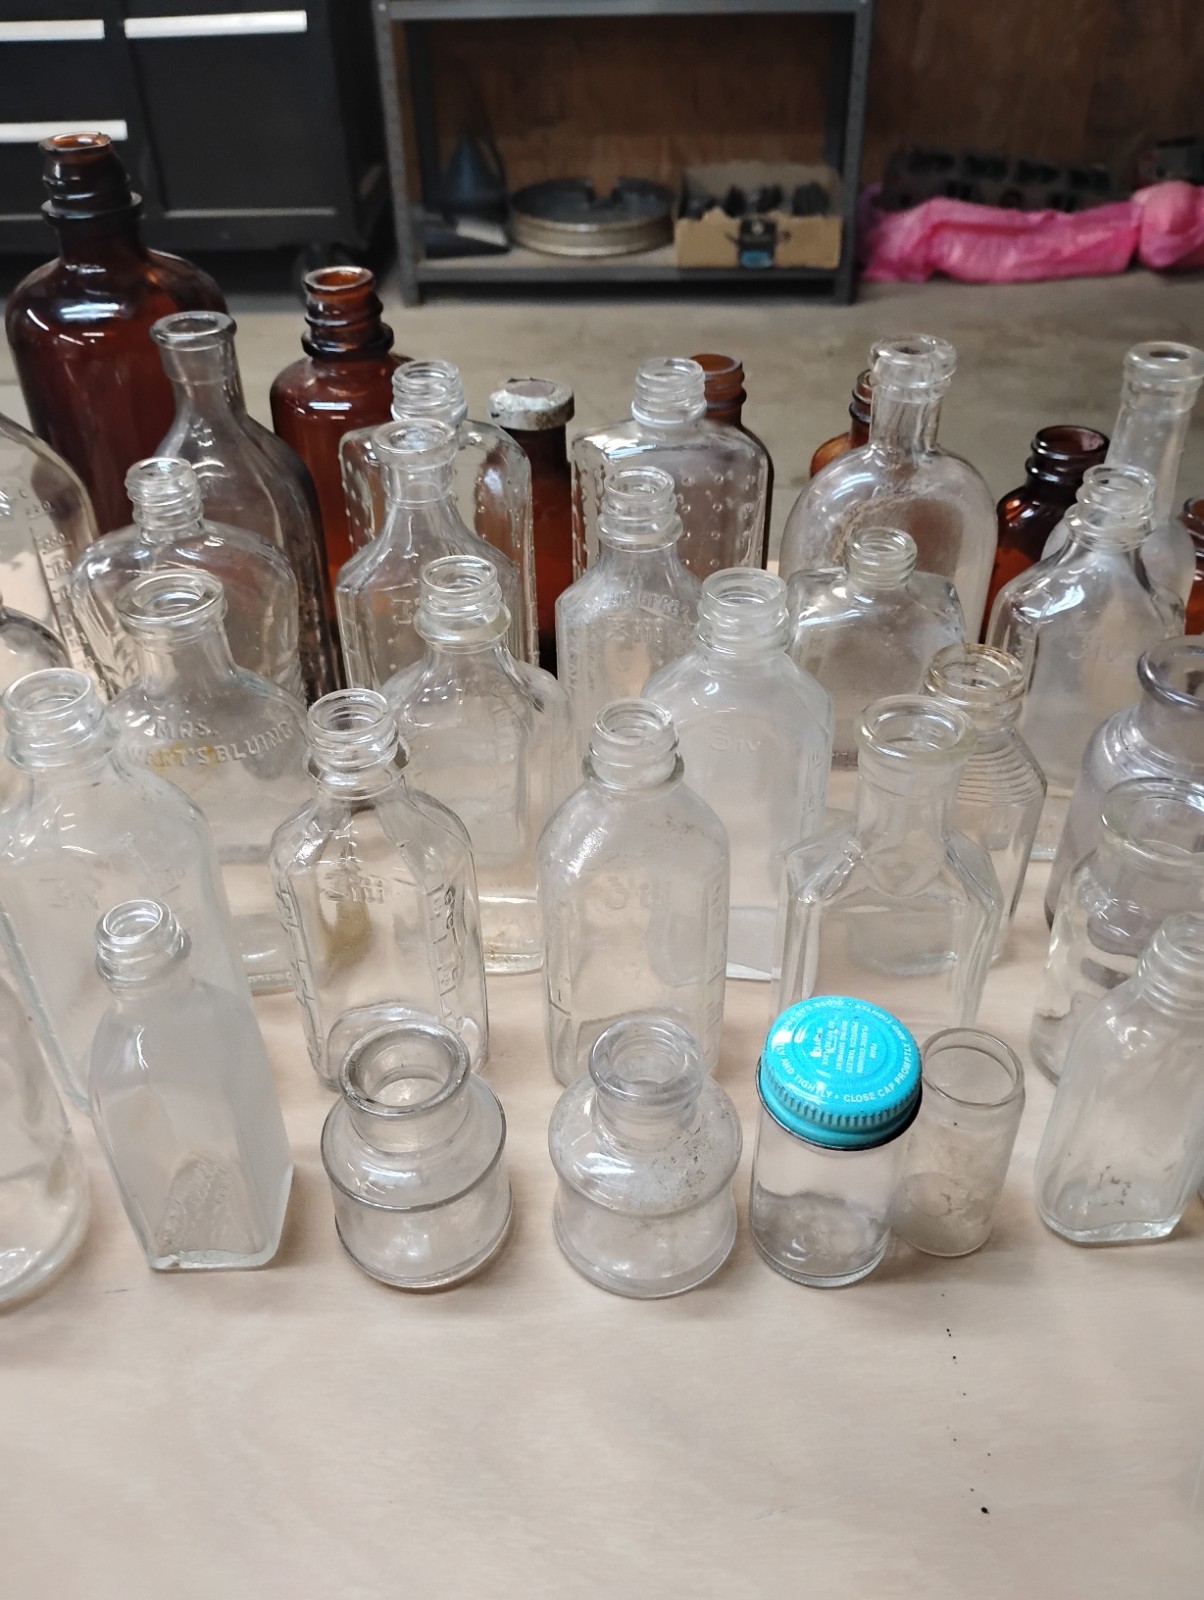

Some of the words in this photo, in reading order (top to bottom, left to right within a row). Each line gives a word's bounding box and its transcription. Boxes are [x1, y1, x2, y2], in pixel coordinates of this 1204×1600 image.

[214, 720, 294, 763] BLUING
[780, 1057, 796, 1076] AND
[793, 1074, 834, 1099] TIGHLY
[843, 1092, 877, 1104] CLOSE
[877, 1082, 896, 1098] CAP
[893, 1042, 912, 1086] PROMPTLY
